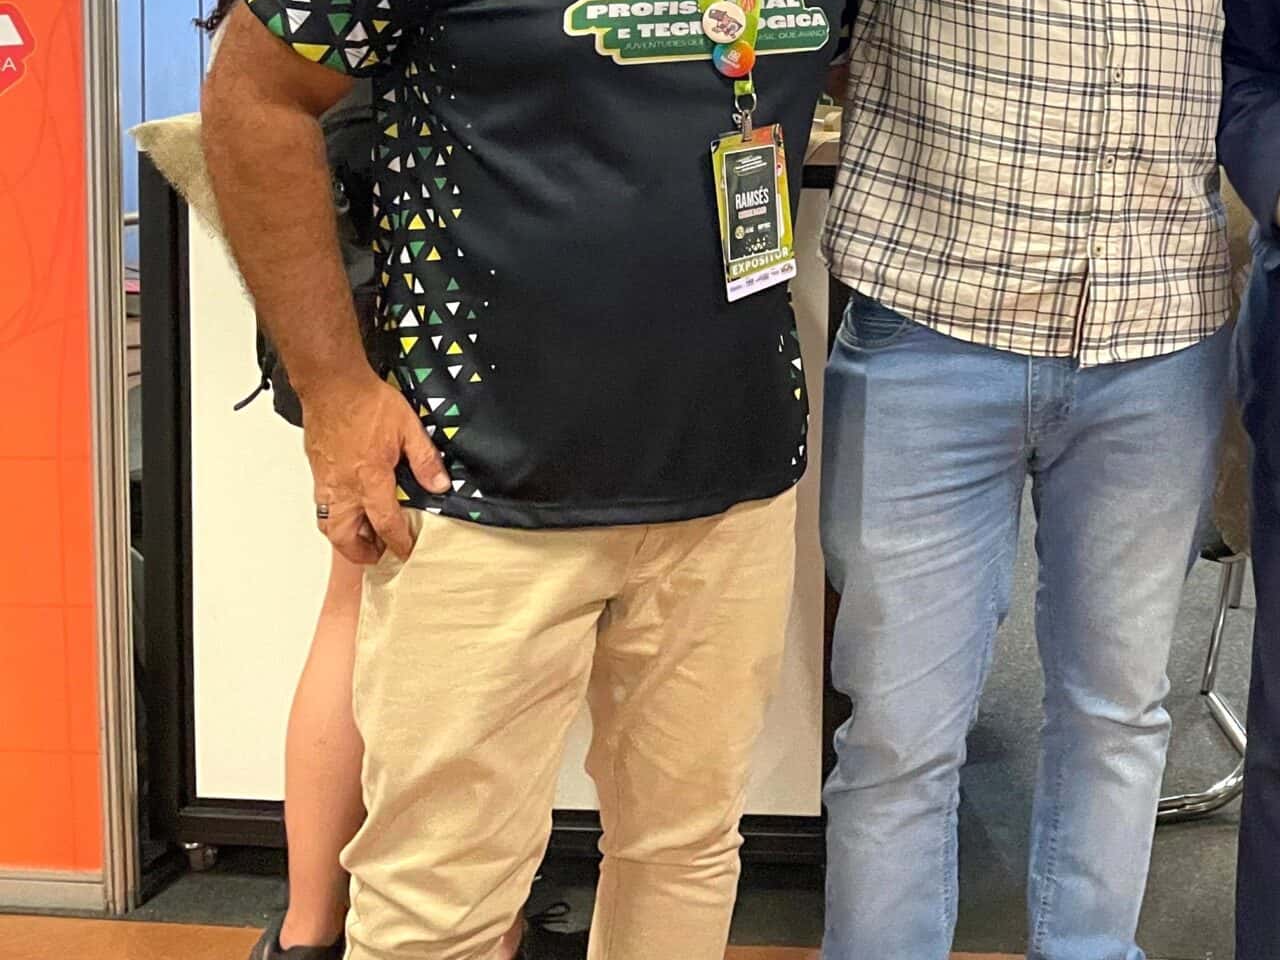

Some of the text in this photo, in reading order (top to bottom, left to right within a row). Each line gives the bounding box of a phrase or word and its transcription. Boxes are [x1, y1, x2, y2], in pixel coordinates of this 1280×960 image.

[618, 28, 631, 39] E
[735, 186, 769, 209] RAMSÉS
[732, 246, 789, 276] EXPOSITOR
